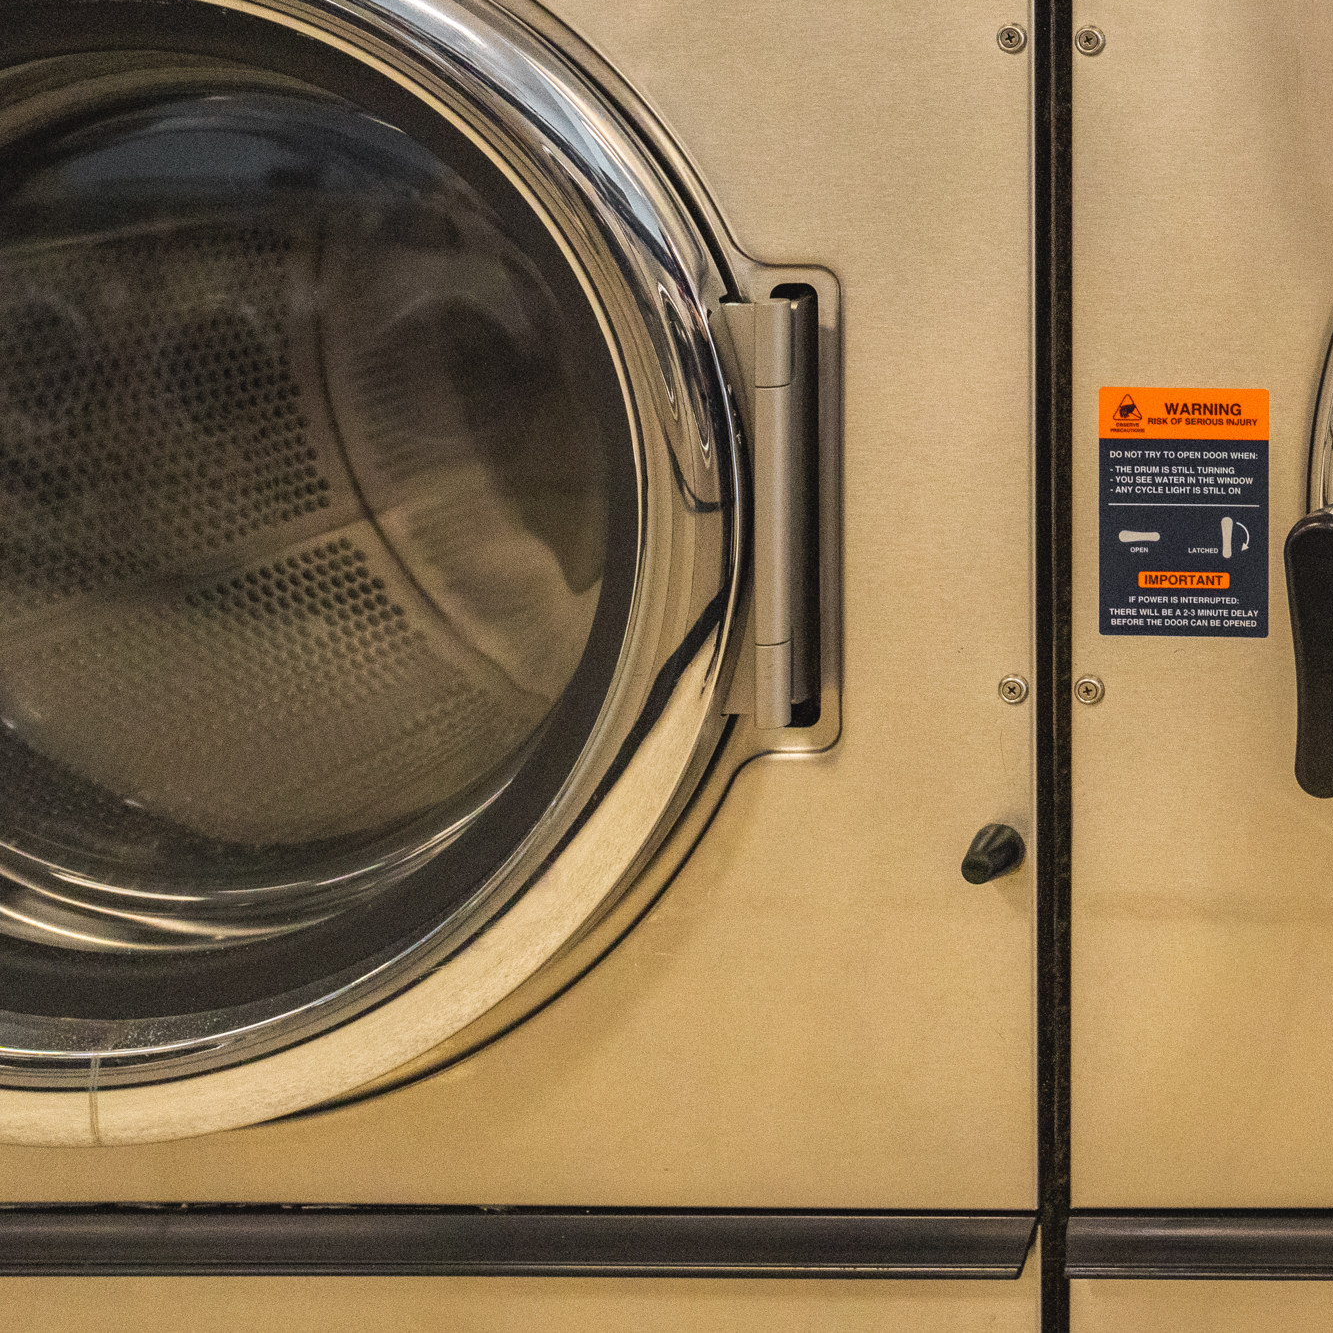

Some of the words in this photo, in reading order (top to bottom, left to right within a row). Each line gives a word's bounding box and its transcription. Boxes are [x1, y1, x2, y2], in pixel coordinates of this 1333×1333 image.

[1164, 402, 1242, 416] WARNING
[1147, 417, 1167, 425] RISK
[1170, 418, 1182, 426] OF
[1184, 418, 1223, 426] SERIOUS
[1225, 418, 1258, 427] INJURY
[1109, 450, 1122, 459] DO
[1123, 451, 1142, 459] NOT
[1144, 451, 1160, 459] TRY
[1163, 451, 1175, 459] TO
[1176, 451, 1201, 460] OPEN
[1202, 451, 1228, 460] DOOR
[1229, 452, 1258, 460] WHEN:
[1144, 575, 1223, 586] IMPORTANT
